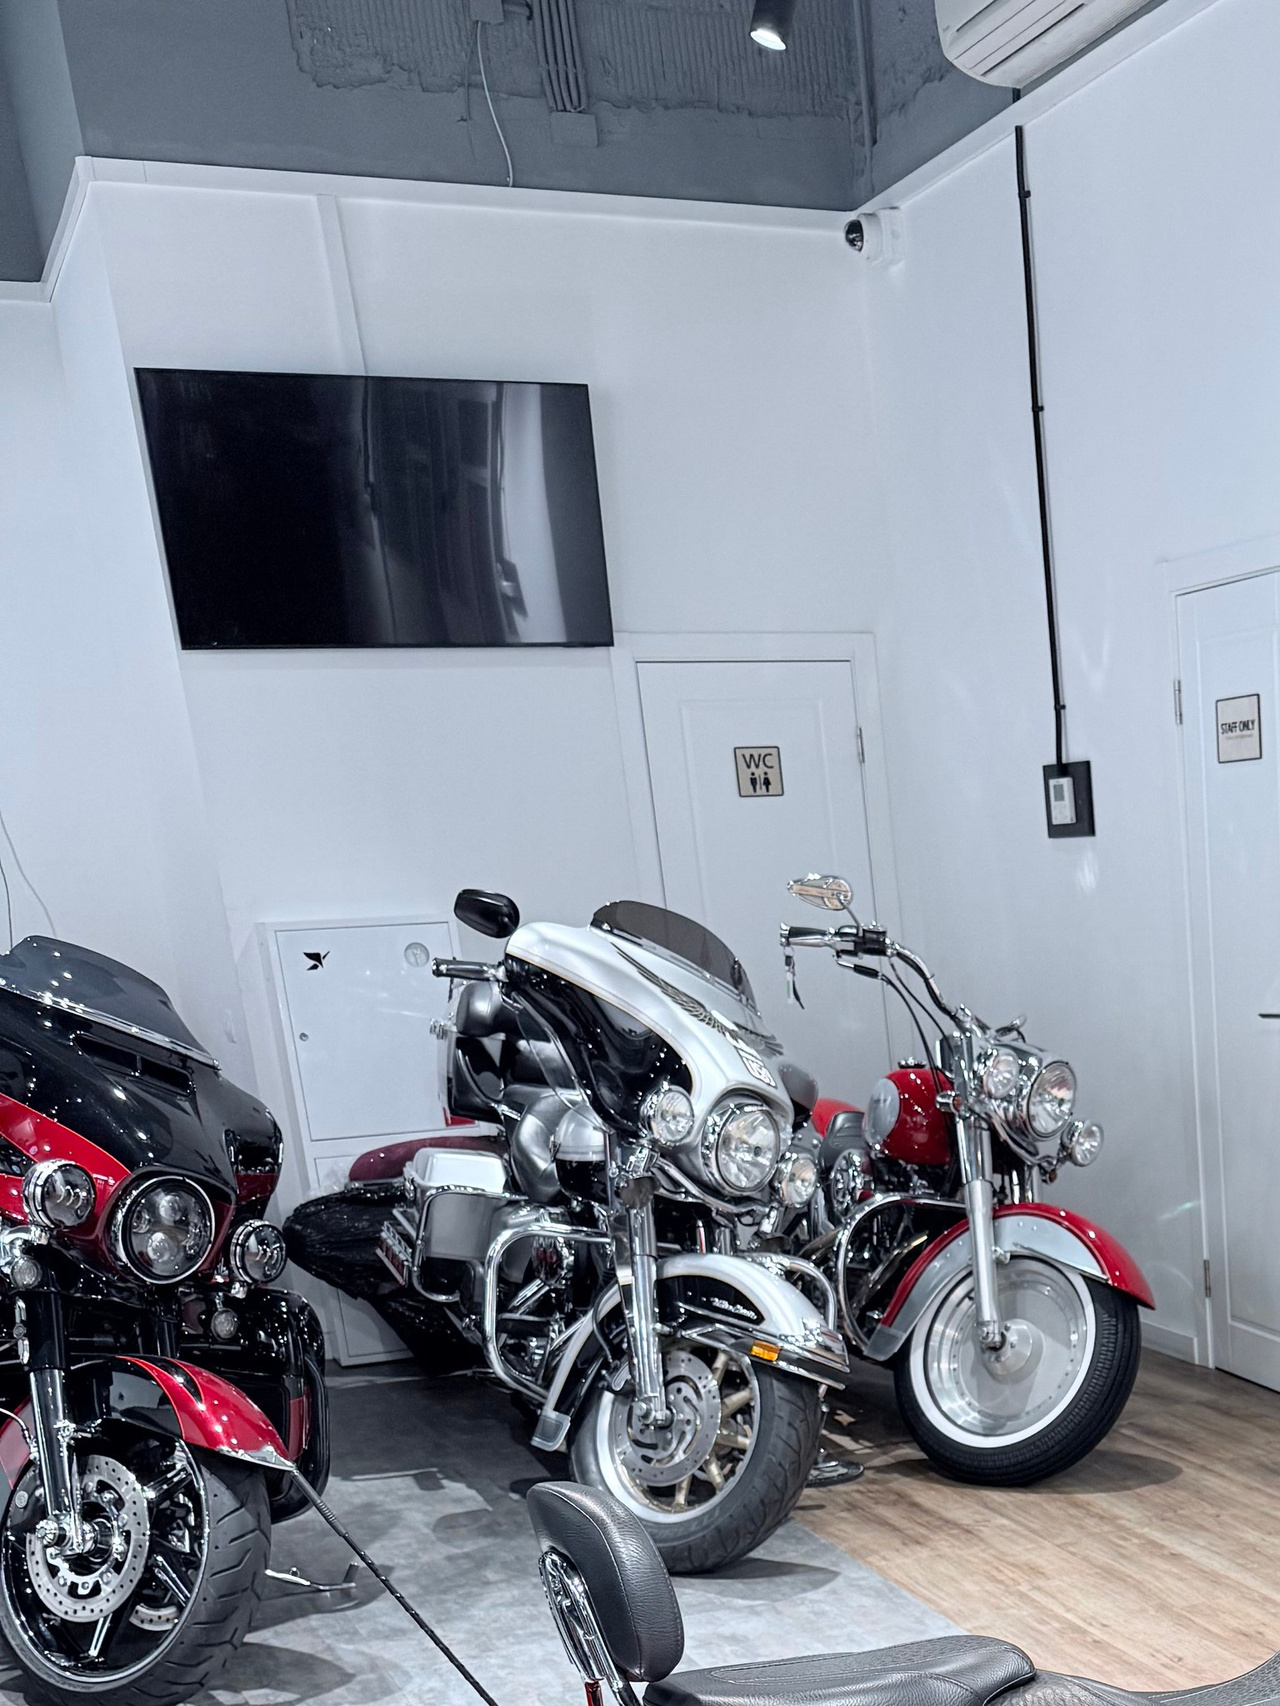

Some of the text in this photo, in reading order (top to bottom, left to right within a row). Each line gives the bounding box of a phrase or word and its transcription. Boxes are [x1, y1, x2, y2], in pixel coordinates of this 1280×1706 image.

[1220, 718, 1256, 735] STAFF ONLY
[741, 753, 775, 770] WC
